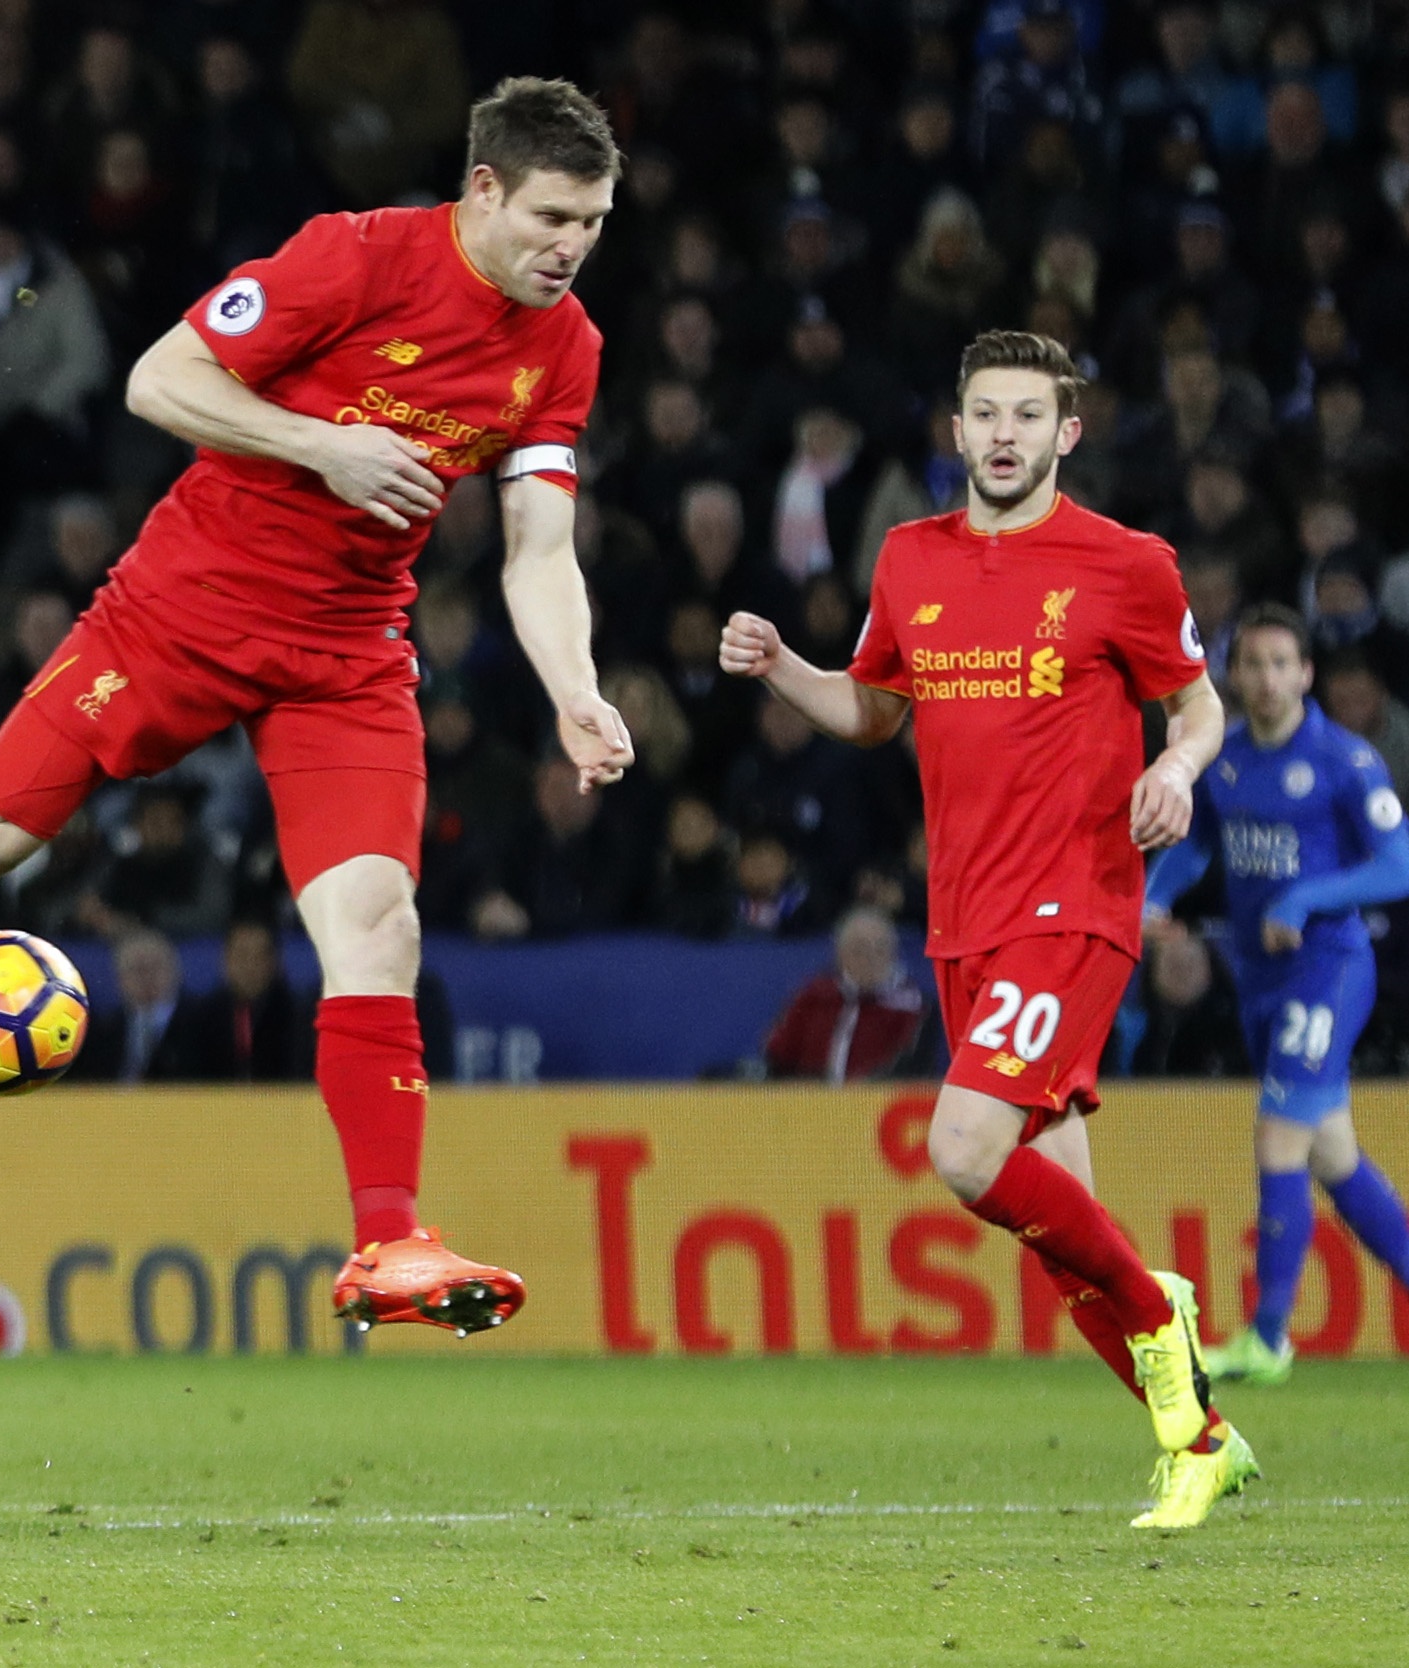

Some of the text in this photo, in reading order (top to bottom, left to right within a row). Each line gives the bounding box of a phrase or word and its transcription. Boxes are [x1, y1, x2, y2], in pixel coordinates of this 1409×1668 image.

[361, 386, 488, 445] Standard
[912, 645, 1023, 673] Standard
[912, 674, 1023, 701] Chartered
[968, 979, 1062, 1063] 20
[1277, 999, 1334, 1062] 28
